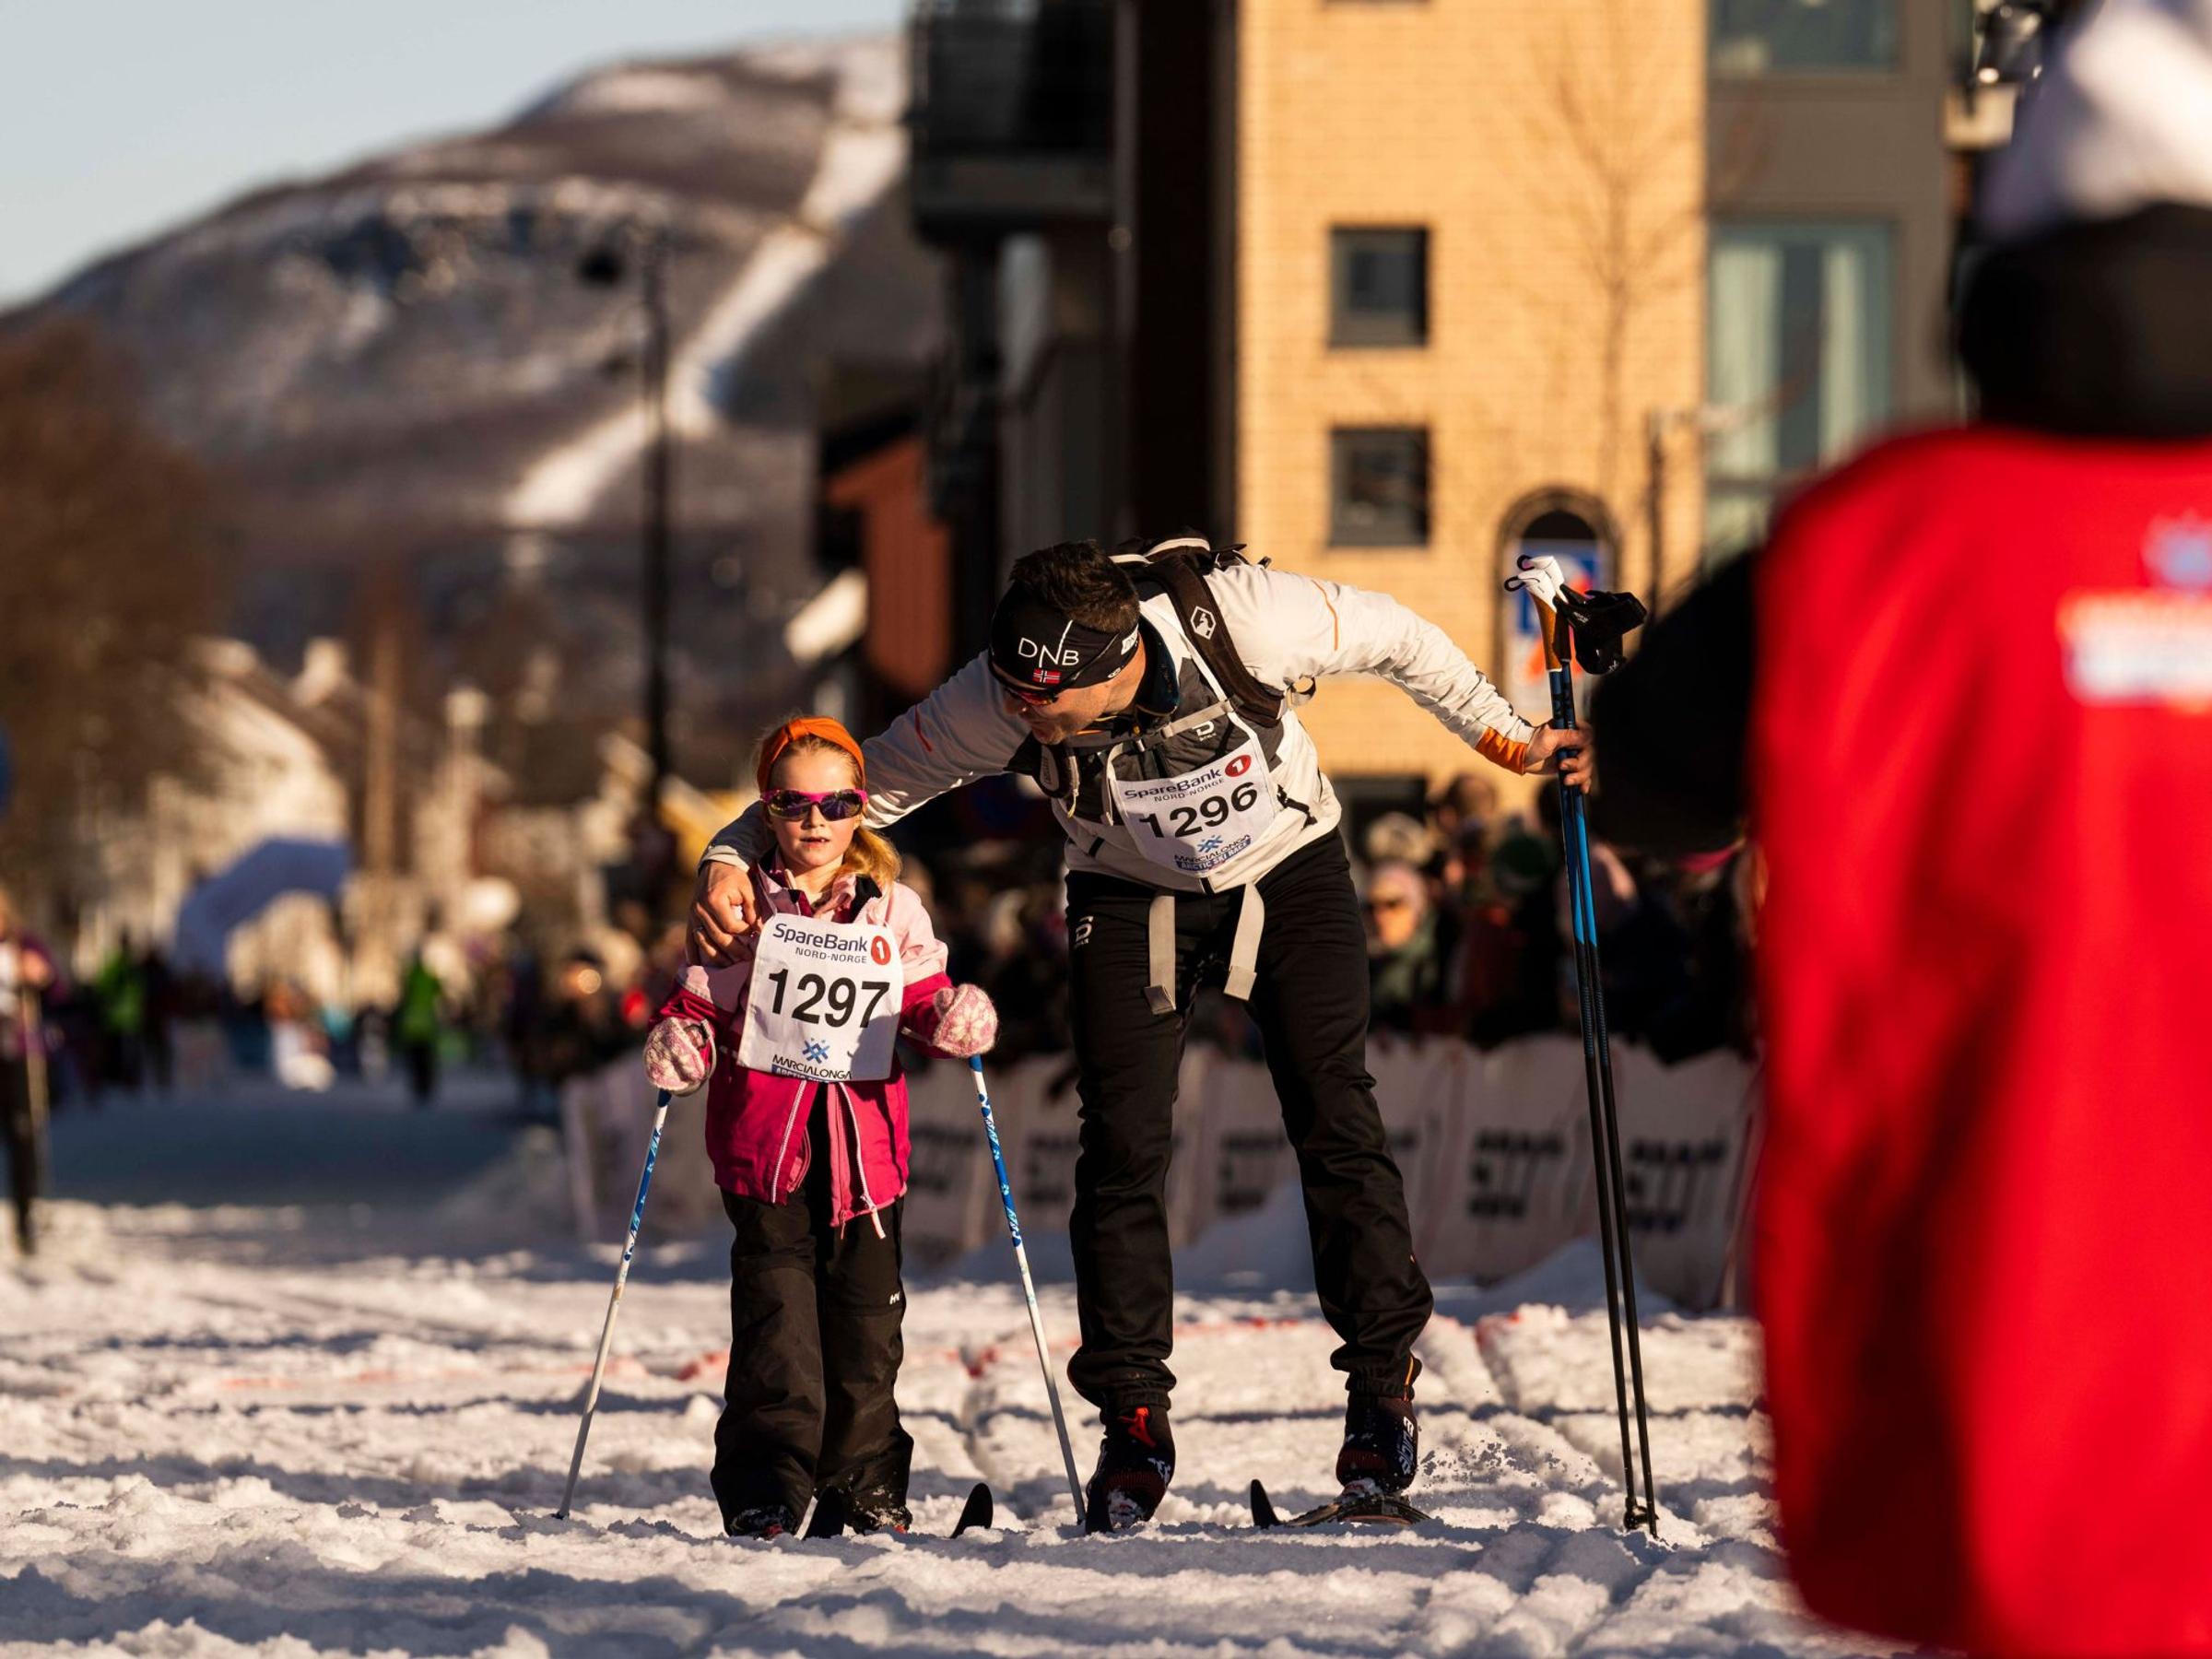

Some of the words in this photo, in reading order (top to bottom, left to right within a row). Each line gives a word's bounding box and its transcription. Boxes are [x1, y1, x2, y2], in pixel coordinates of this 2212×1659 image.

[1018, 620, 1079, 668] DNB
[1124, 769, 1222, 800] SpareBank
[1154, 778, 1225, 802] NORD-NORGE
[1139, 782, 1258, 838] 1296
[772, 923, 868, 952] SpareBank
[795, 947, 867, 963] NORD-NORGE
[769, 969, 890, 1029] 1297
[772, 1054, 853, 1079] MARCIALONGA
